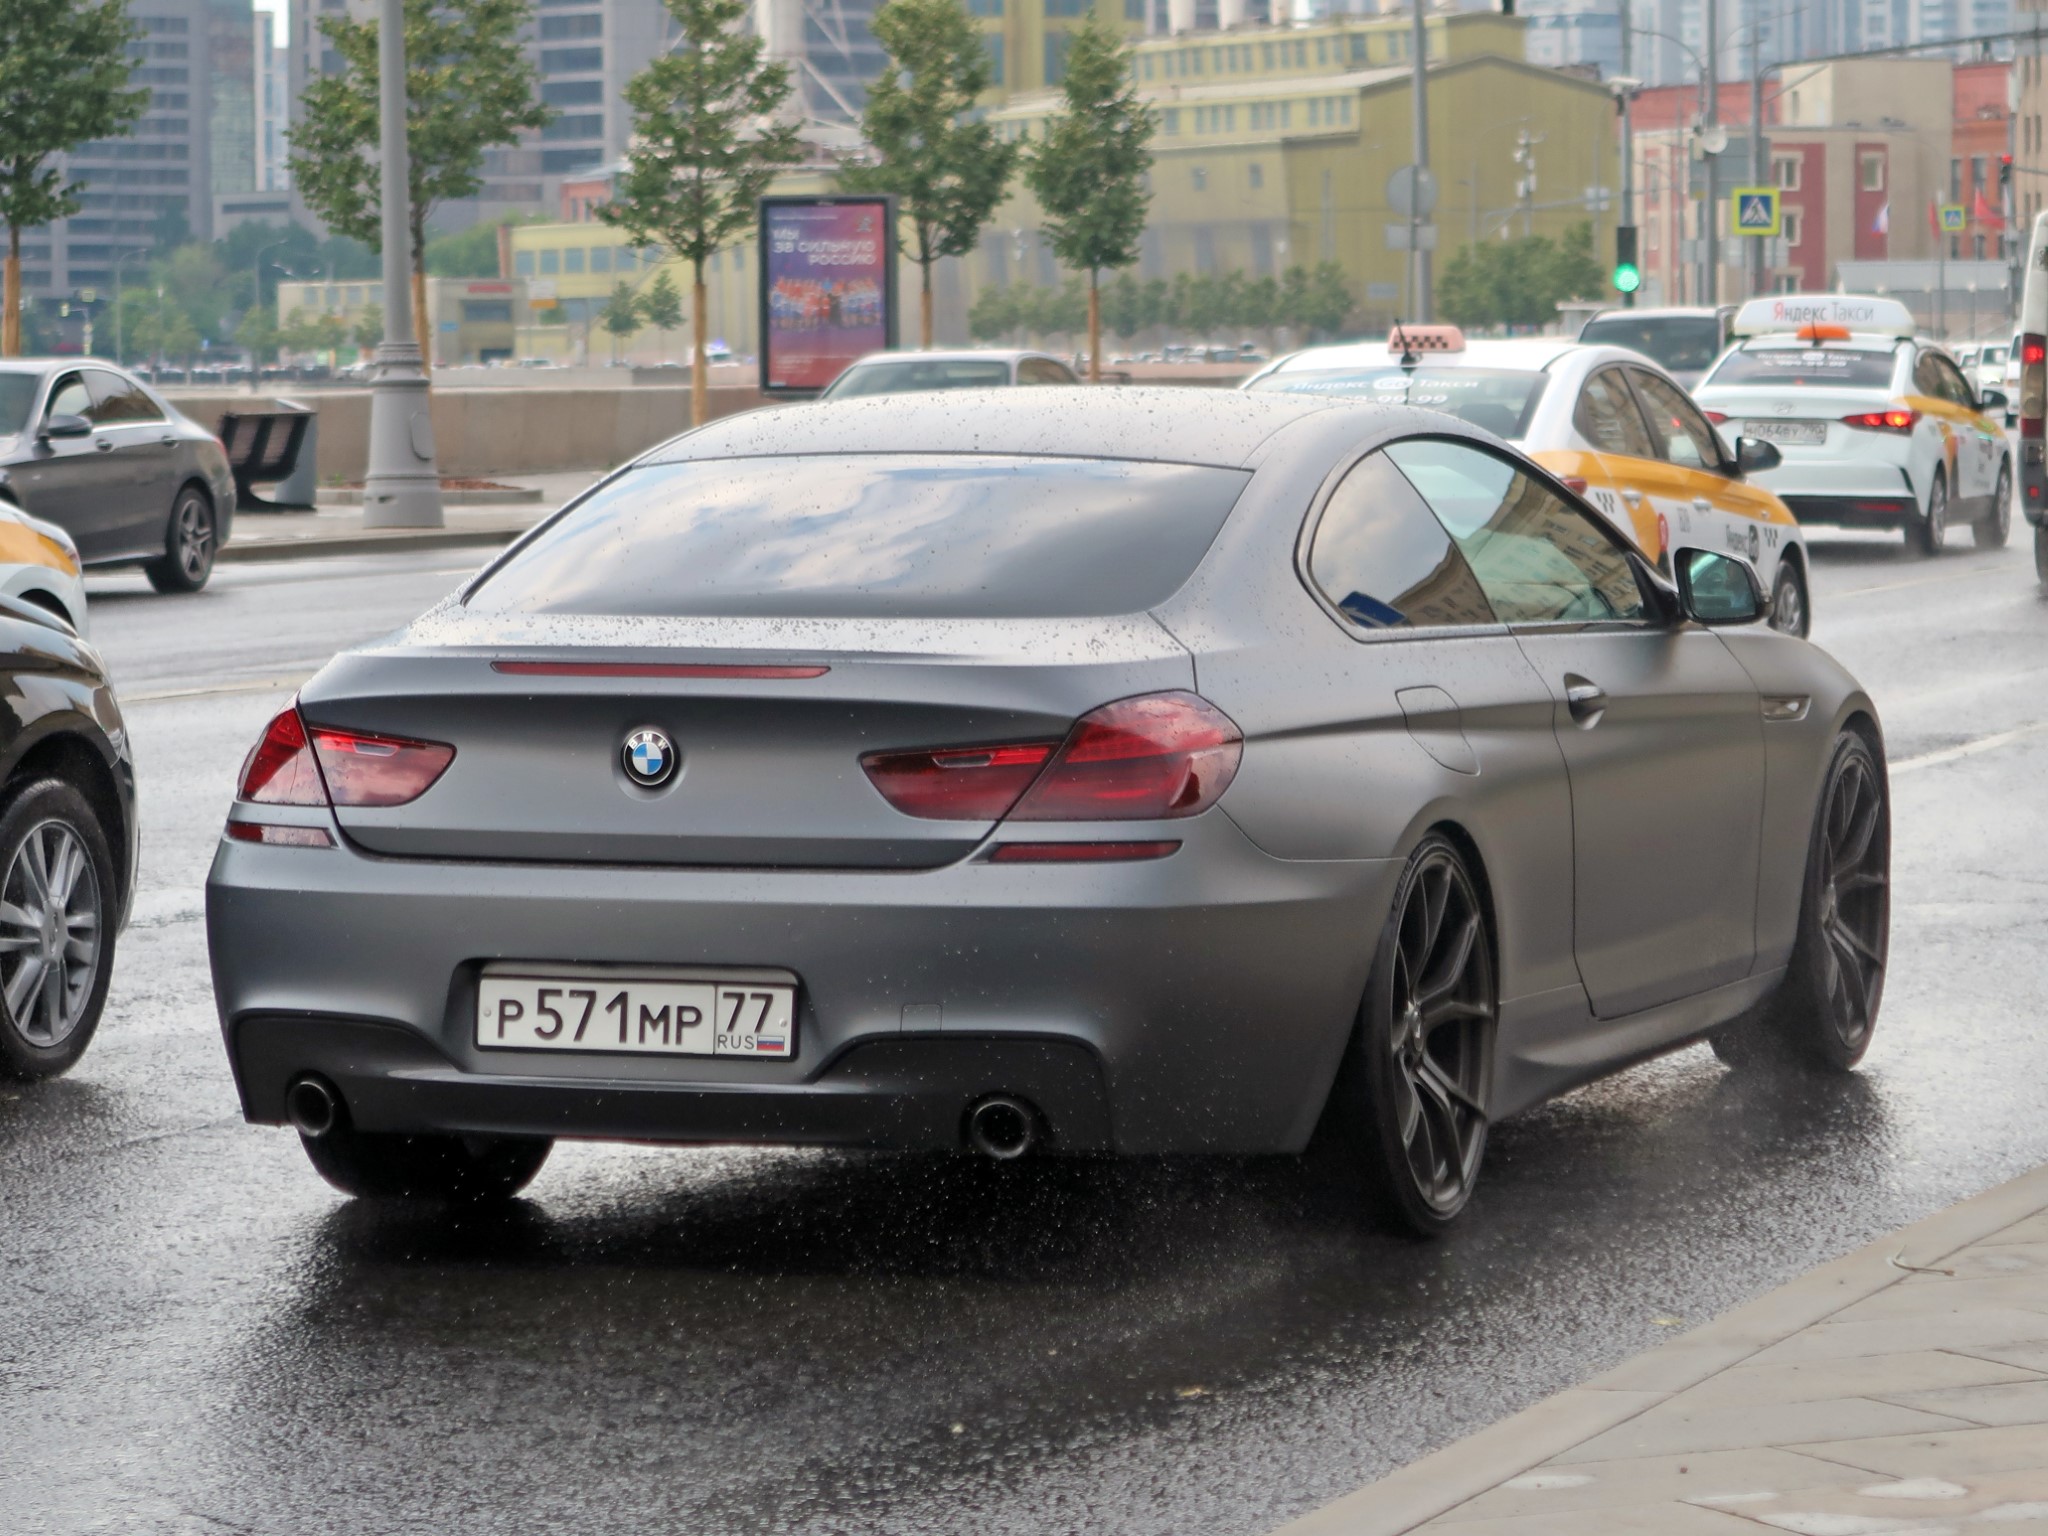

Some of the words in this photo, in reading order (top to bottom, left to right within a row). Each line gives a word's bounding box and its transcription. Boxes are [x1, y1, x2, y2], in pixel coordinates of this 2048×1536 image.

[1773, 302, 1827, 323] Яндекс
[1831, 301, 1875, 321] Такси
[628, 732, 669, 750] BMW
[497, 988, 703, 1046] Р571МР
[721, 992, 775, 1035] 77
[717, 1034, 756, 1050] RUS
